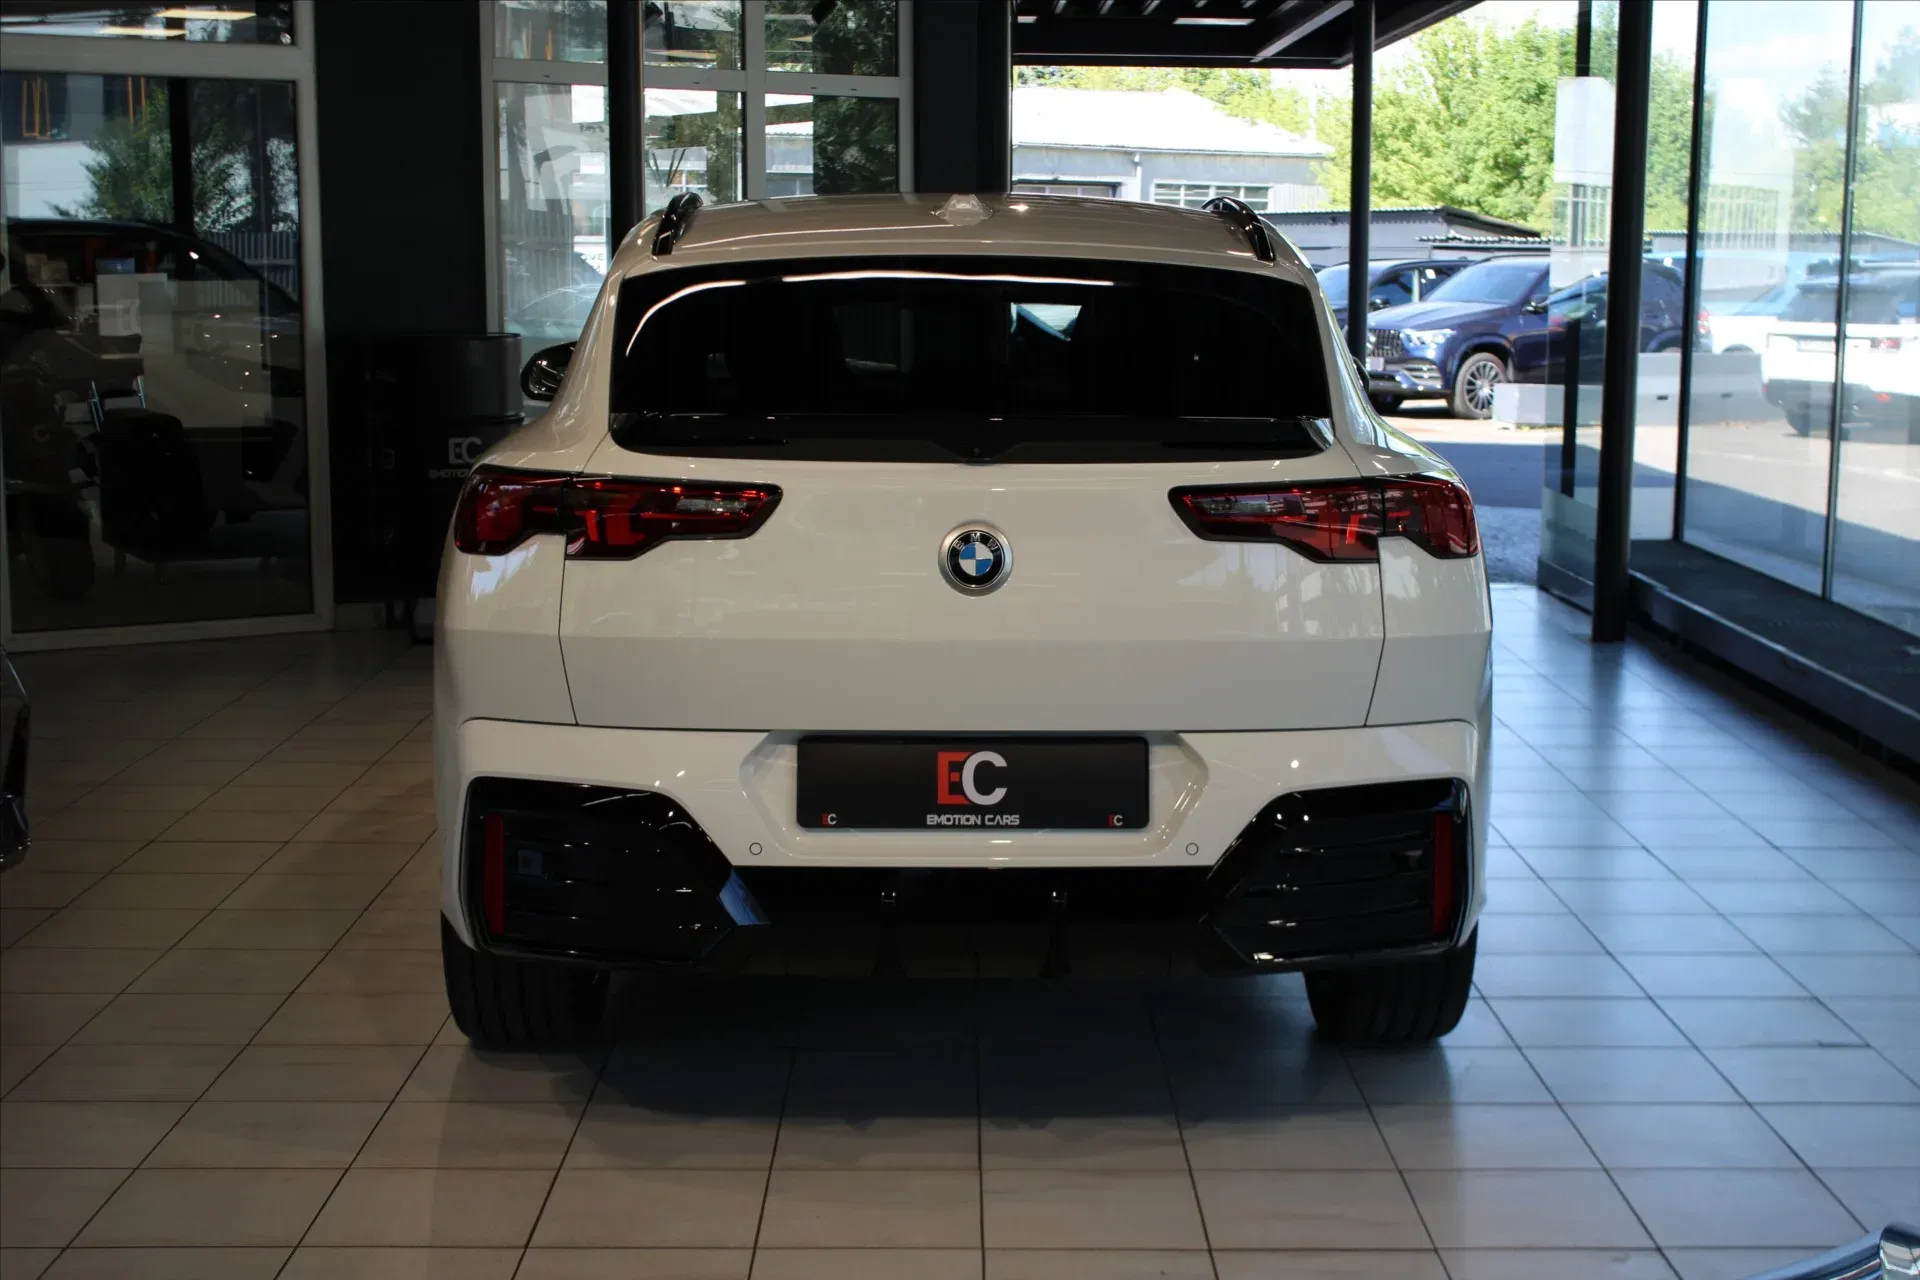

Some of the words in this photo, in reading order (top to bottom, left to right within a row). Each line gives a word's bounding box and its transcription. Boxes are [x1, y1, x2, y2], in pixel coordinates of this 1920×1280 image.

[448, 436, 483, 465] EC
[953, 532, 999, 551] BMW
[937, 751, 1008, 805] EC
[822, 813, 837, 825] EC
[926, 814, 981, 826] EMOTION
[984, 814, 1020, 826] CARS
[1107, 814, 1123, 826] EC
